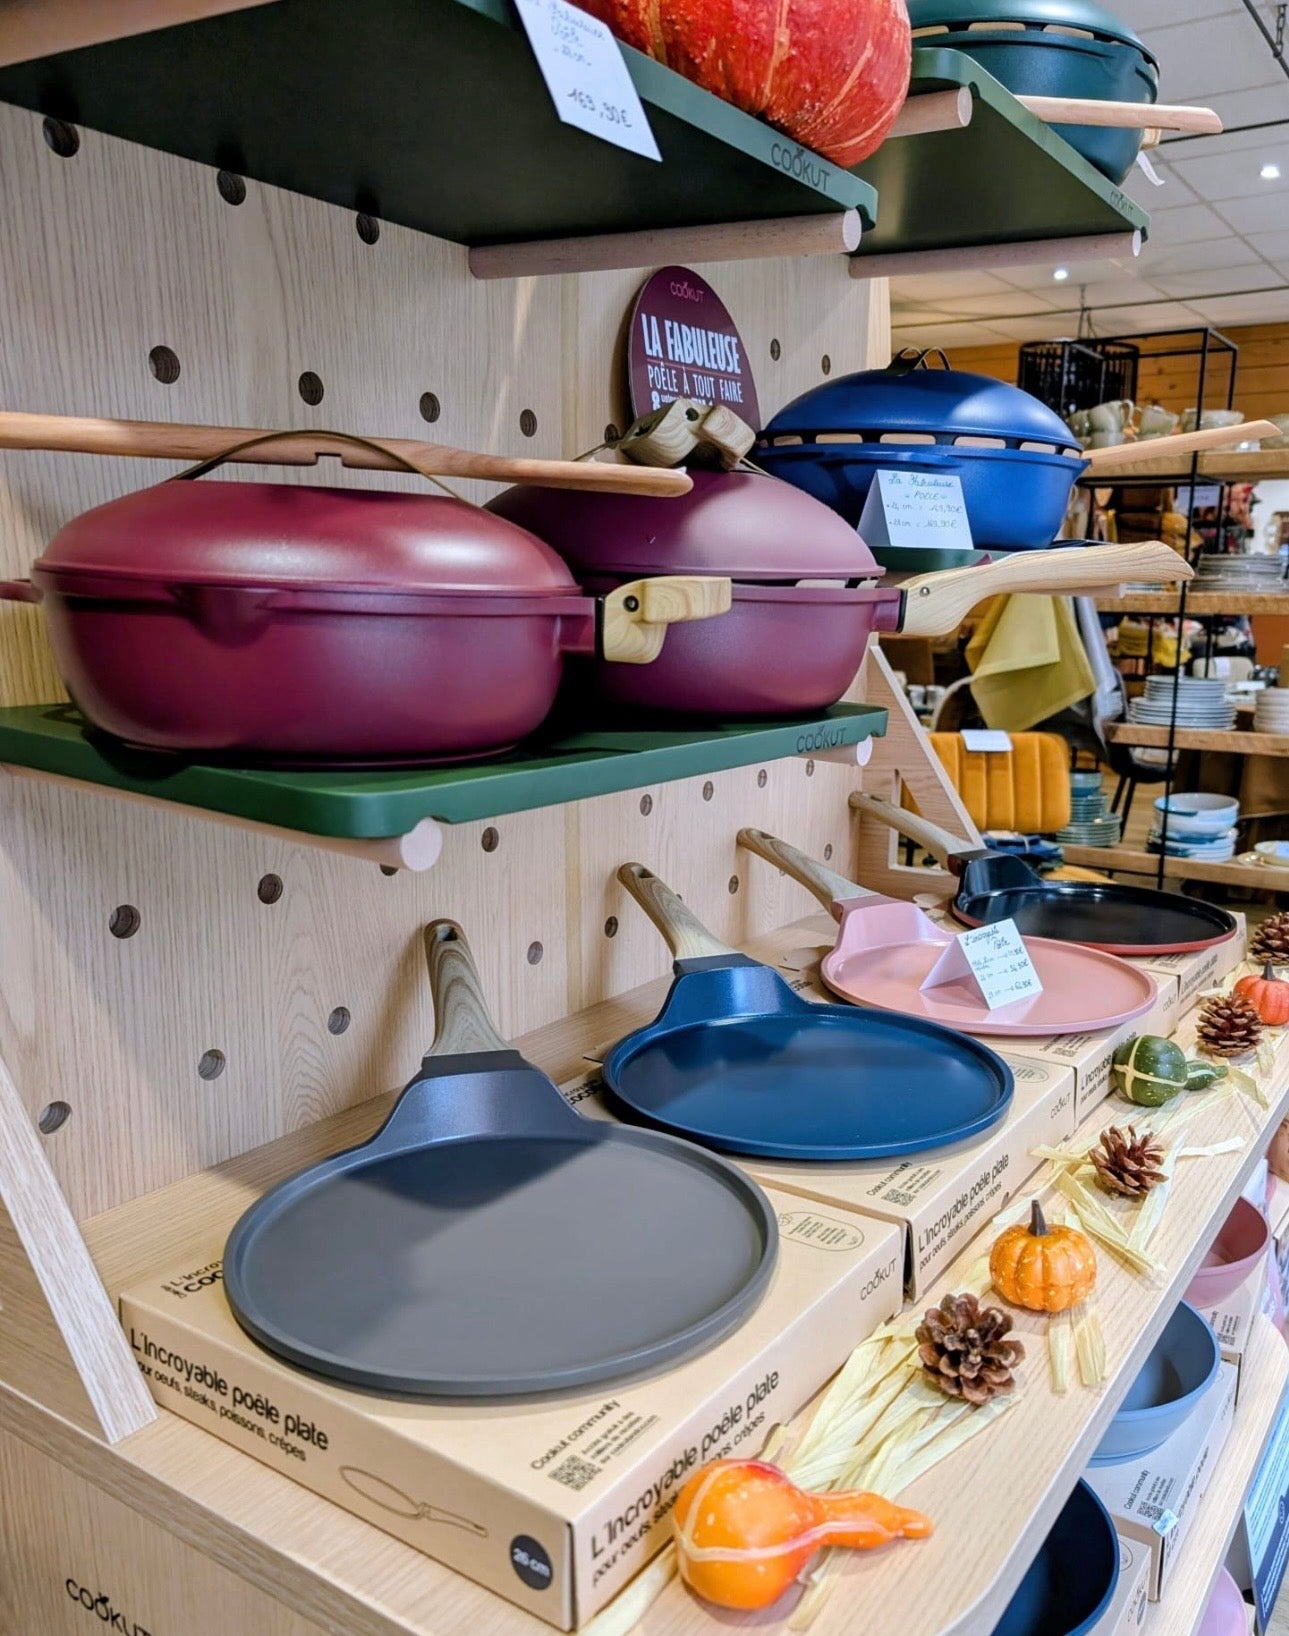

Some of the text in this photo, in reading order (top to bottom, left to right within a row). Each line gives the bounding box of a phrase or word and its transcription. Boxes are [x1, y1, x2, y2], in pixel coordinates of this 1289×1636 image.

[771, 143, 830, 192] COOKUT
[670, 281, 704, 302] COOKUT
[641, 313, 742, 374] LA FABULEUSE
[647, 361, 679, 393] POÊLE
[682, 366, 690, 394] À
[692, 373, 716, 398] TOUT
[719, 379, 744, 403] FAIRE
[796, 725, 847, 752] COOKUT
[860, 1258, 897, 1301] COOKUT
[232, 1386, 280, 1425] poêle
[284, 1413, 330, 1451] plate
[530, 1439, 571, 1470] Cookut
[567, 1399, 621, 1442] community
[702, 1404, 743, 1461] poêle
[746, 1371, 780, 1420] plate
[268, 1431, 307, 1462] crêpes
[593, 1551, 618, 1588] pour
[733, 1410, 766, 1446] crêpes
